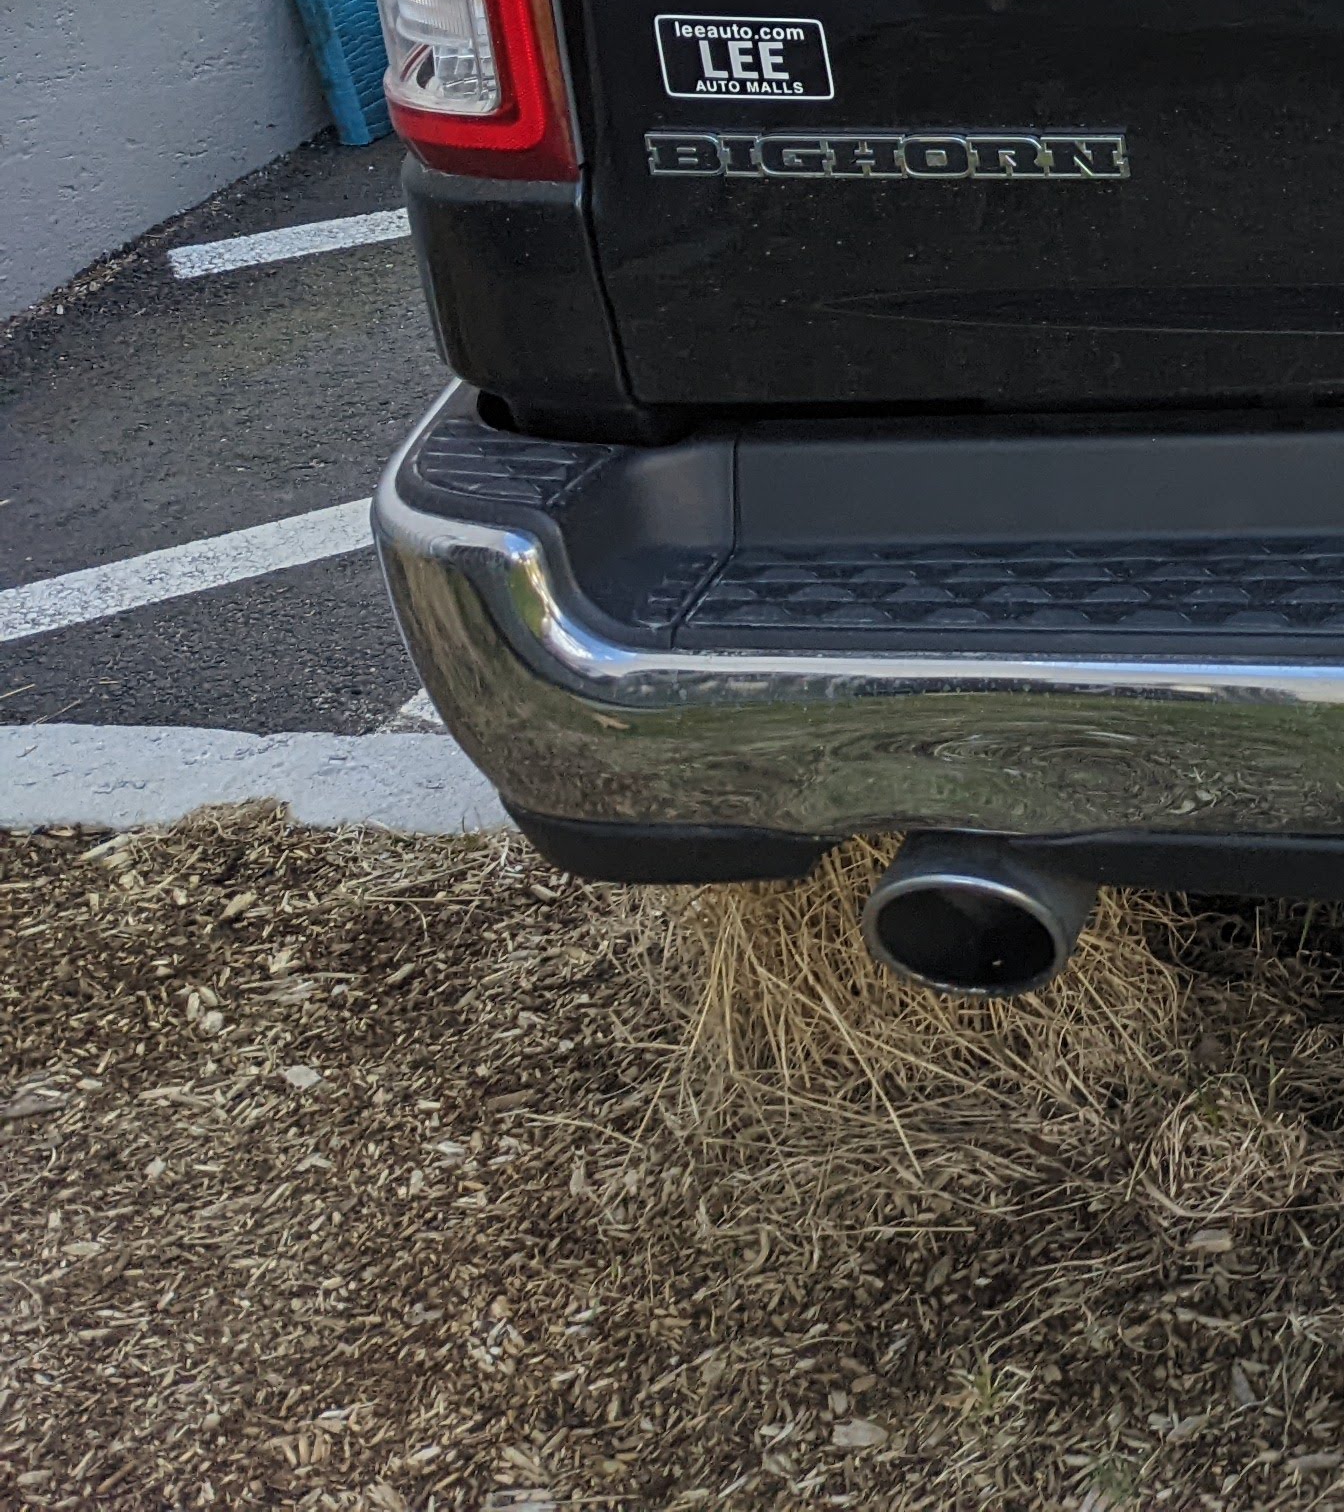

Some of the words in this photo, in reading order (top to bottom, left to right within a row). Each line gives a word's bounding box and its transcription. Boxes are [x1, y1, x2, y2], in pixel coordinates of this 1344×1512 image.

[674, 20, 805, 41] leeauto.com
[698, 40, 790, 80] LEE
[695, 79, 741, 94] AUTO
[746, 80, 805, 95] MALLS
[644, 129, 1130, 179] BIGHORN
